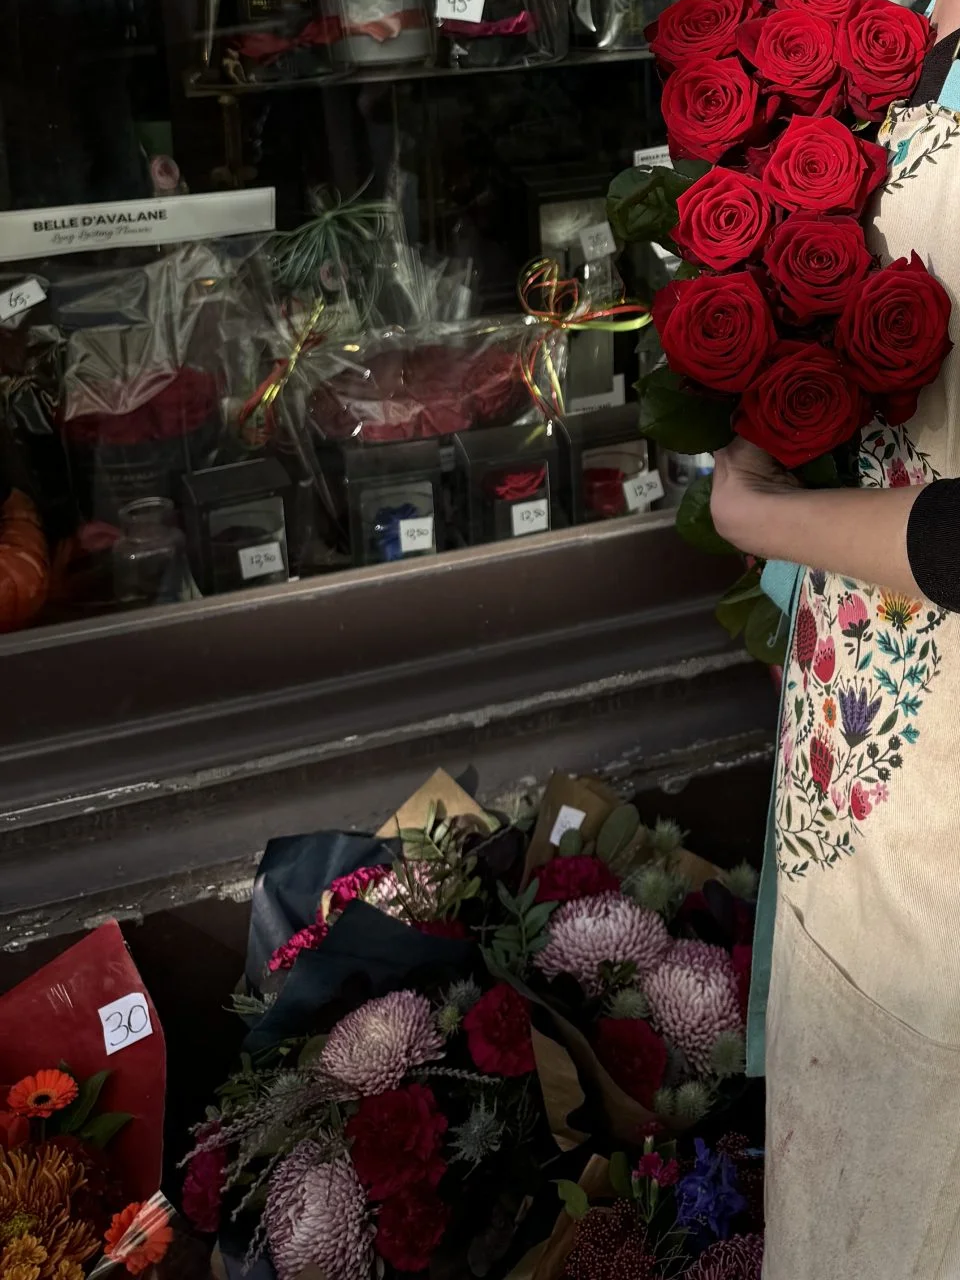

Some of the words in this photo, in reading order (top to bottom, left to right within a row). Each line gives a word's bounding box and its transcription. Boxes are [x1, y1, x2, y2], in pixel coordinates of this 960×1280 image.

[33, 216, 82, 232] BELLE
[82, 209, 168, 227] D'AVALANE
[634, 482, 657, 497] 12,50
[520, 508, 545, 523] 12,50
[249, 553, 276, 569] 12,50
[105, 1005, 148, 1046] 30
